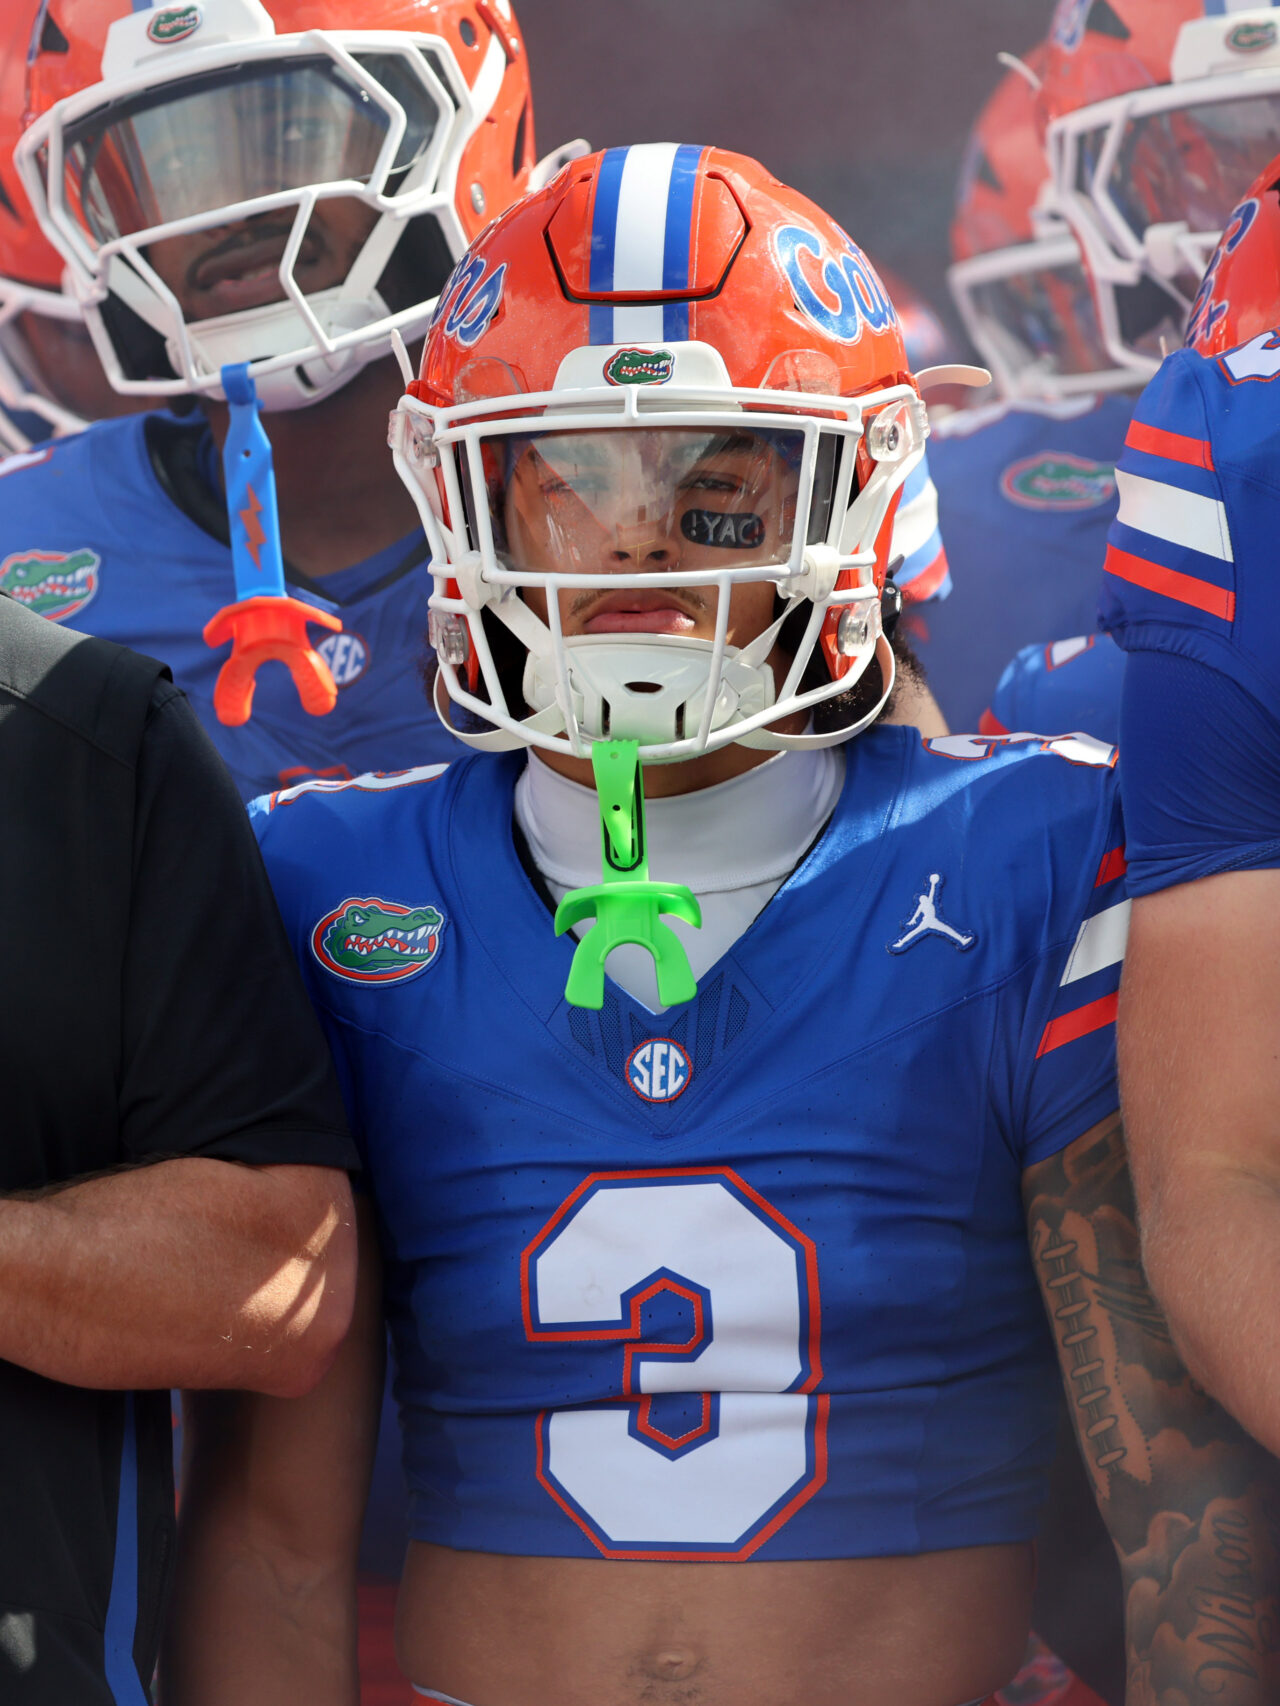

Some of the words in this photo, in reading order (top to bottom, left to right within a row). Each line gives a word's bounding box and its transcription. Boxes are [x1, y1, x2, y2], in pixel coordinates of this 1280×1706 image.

[316, 633, 366, 685] SEC
[632, 1043, 685, 1098] SEC
[520, 1165, 830, 1562] 3
